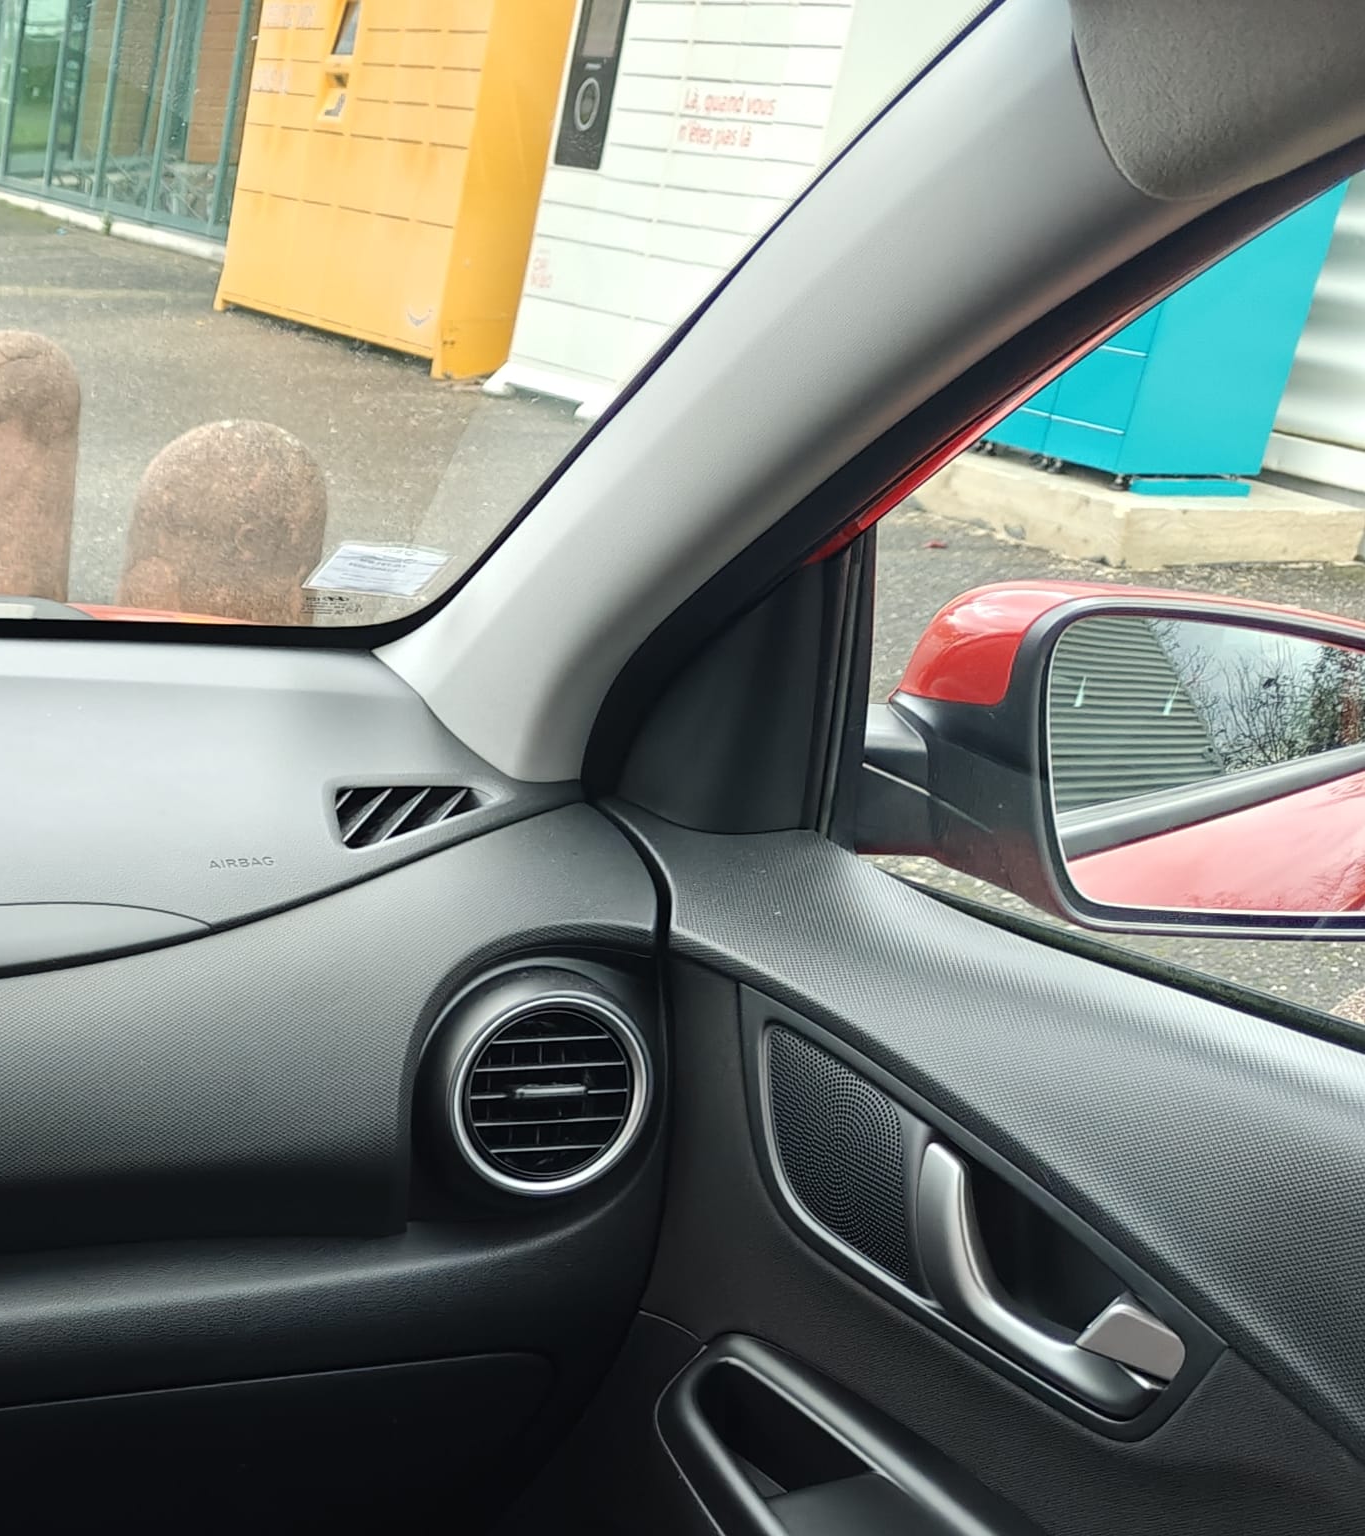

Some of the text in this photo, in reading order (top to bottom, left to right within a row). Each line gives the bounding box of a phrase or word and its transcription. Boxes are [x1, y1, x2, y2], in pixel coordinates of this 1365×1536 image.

[704, 90, 746, 116] quand
[747, 97, 777, 116] vous
[677, 120, 713, 144] n'êtes
[713, 127, 739, 150] pas
[209, 856, 275, 869] AIRBAG
